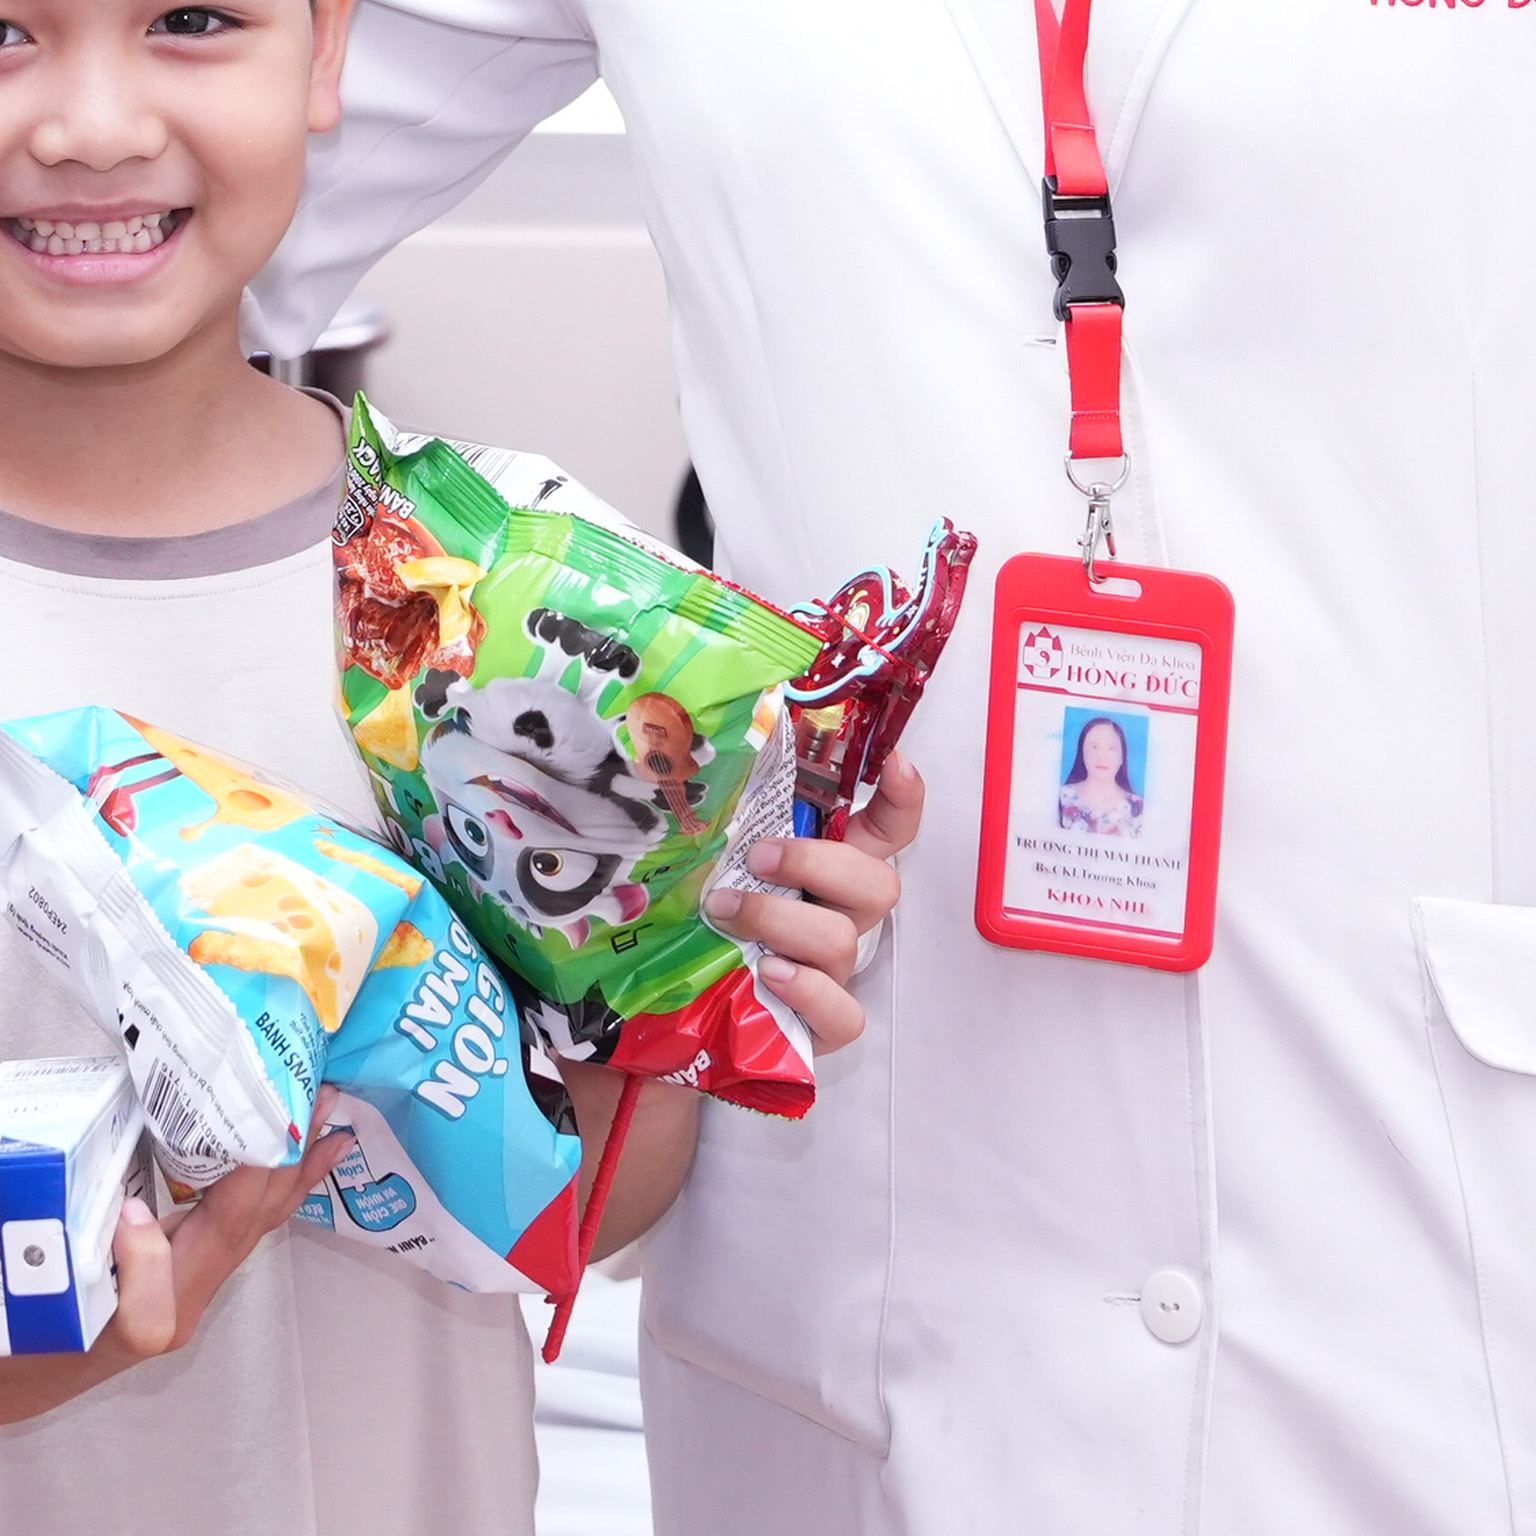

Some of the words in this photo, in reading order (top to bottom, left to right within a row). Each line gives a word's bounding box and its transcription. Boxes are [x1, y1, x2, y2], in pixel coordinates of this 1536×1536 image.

[1145, 668, 1198, 698] ĐỨC
[1161, 655, 1195, 671] Khoa
[1046, 888, 1104, 908] KHOA
[1110, 897, 1145, 914] NHI
[396, 949, 472, 1051] MAI
[253, 1008, 295, 1058] BÁNH
[415, 961, 509, 1119] GIÒN
